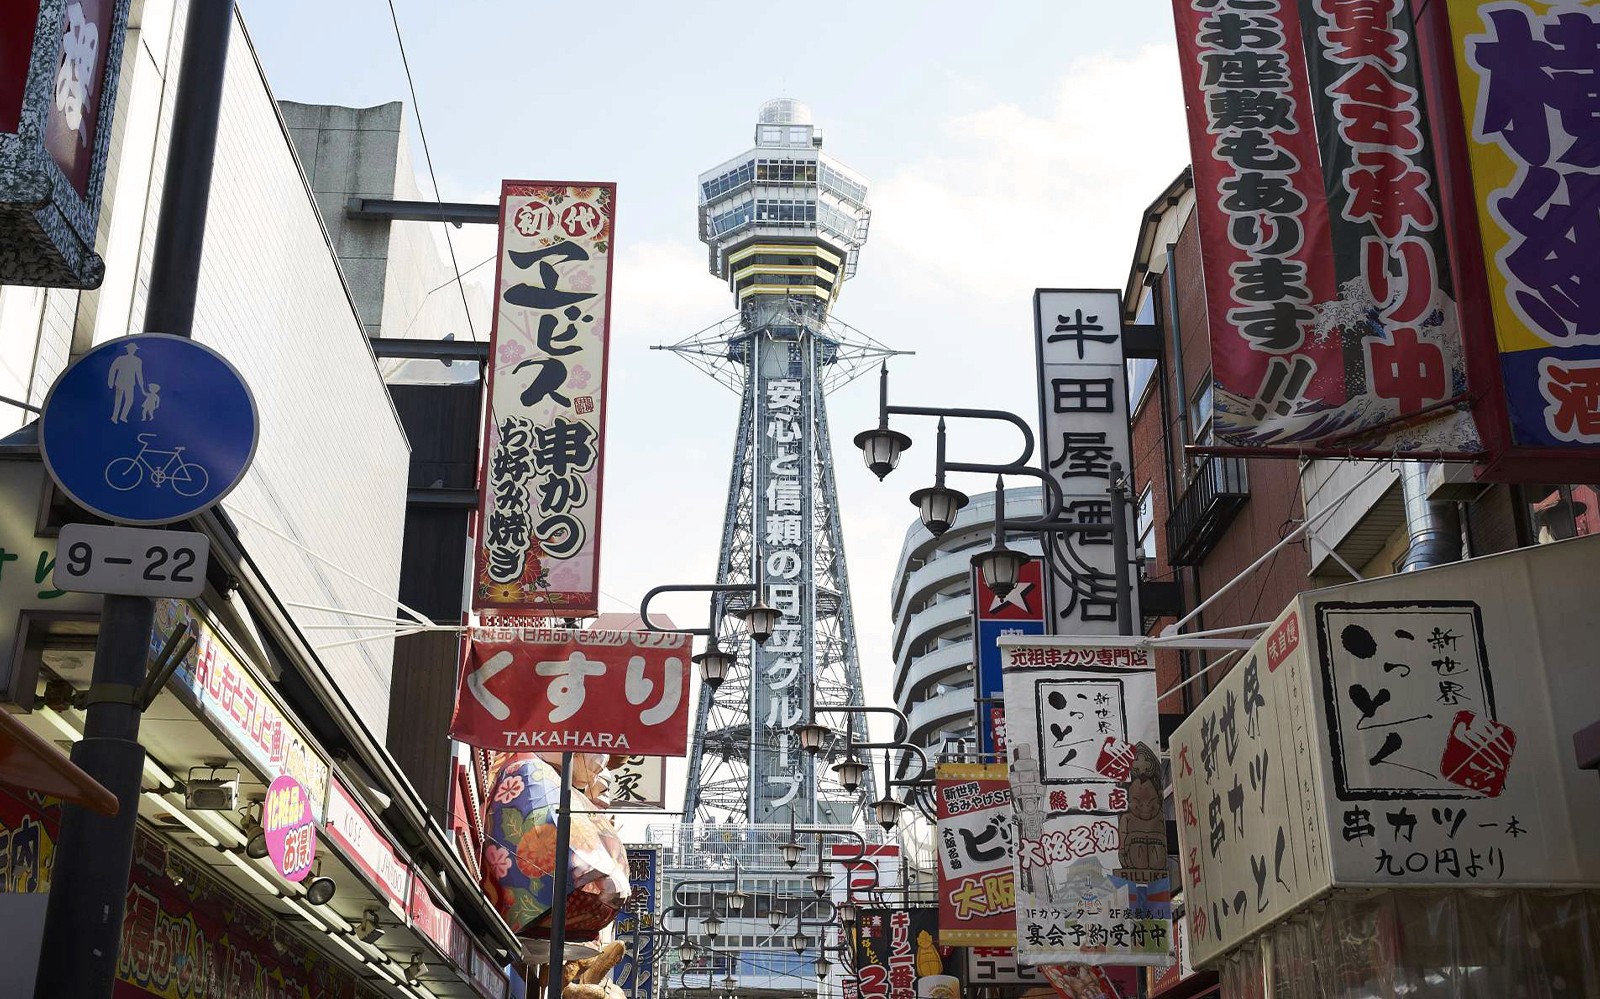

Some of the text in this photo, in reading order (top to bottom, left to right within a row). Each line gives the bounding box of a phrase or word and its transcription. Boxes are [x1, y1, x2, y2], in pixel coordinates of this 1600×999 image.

[515, 201, 602, 237] 初代
[1195, 0, 1314, 421] お座敷もあります!!
[503, 240, 598, 407] エビス
[488, 417, 531, 579] お好み焼き
[536, 418, 596, 556] 串かつ
[1047, 308, 1119, 622] 半田屋酒店
[474, 628, 511, 641] 粧品
[766, 378, 803, 807] 安心と信頼の日立グループ
[196, 640, 290, 775] よしもとテレビ通り
[467, 651, 683, 725] くすり
[1010, 648, 1149, 668] 元祖串カツ専門店
[1341, 624, 1439, 779] いっとく
[1427, 626, 1472, 706] 新世界
[503, 731, 631, 749] TAKAHARA
[1201, 655, 1265, 784] 新世界
[944, 782, 980, 802] 新世界
[1018, 821, 1121, 869] 大阪名物
[1050, 788, 1128, 812] 総本店
[1178, 744, 1208, 943] 大阪名物
[1208, 748, 1270, 864] 串カツ
[1025, 923, 1167, 948] 宴会予約受付中
[1212, 826, 1290, 941] いっとく
[977, 961, 1042, 979] コーヒ
